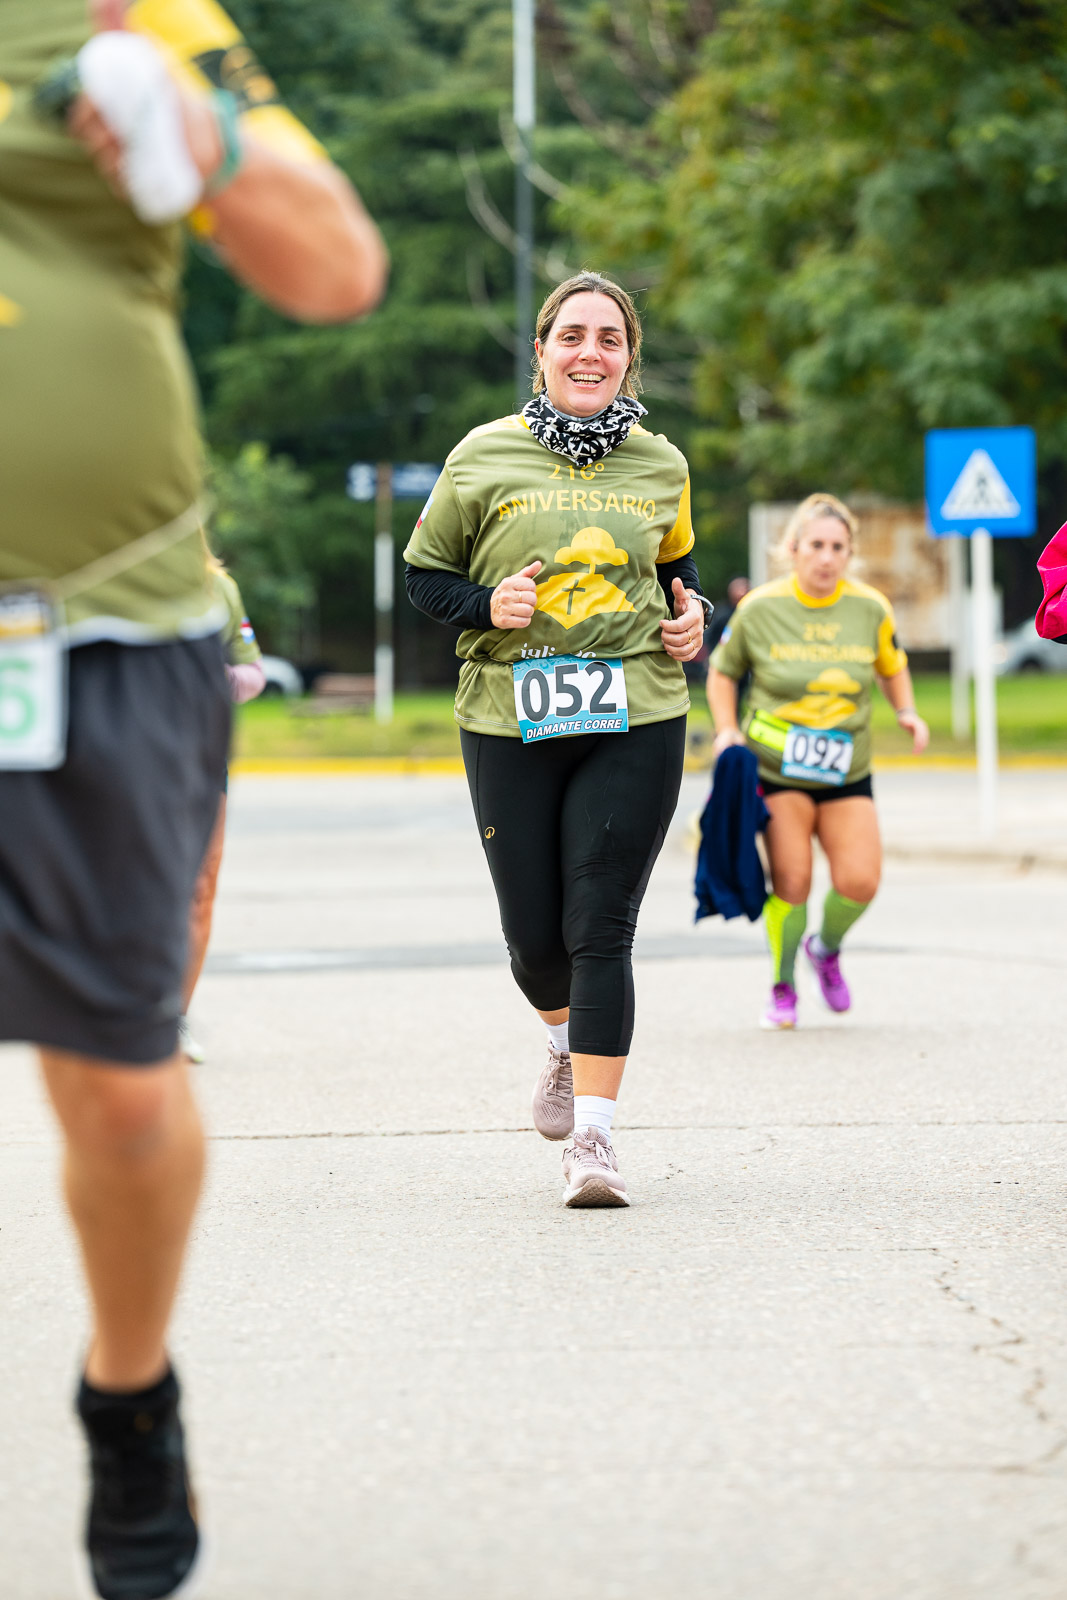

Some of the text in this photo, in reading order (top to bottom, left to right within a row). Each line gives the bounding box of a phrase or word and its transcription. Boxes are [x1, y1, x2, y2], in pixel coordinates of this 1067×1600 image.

[498, 489, 656, 521] ANIVERSARIO
[521, 661, 617, 723] 052
[526, 718, 622, 740] DIAMANTE CORRE
[792, 733, 845, 771] 092
